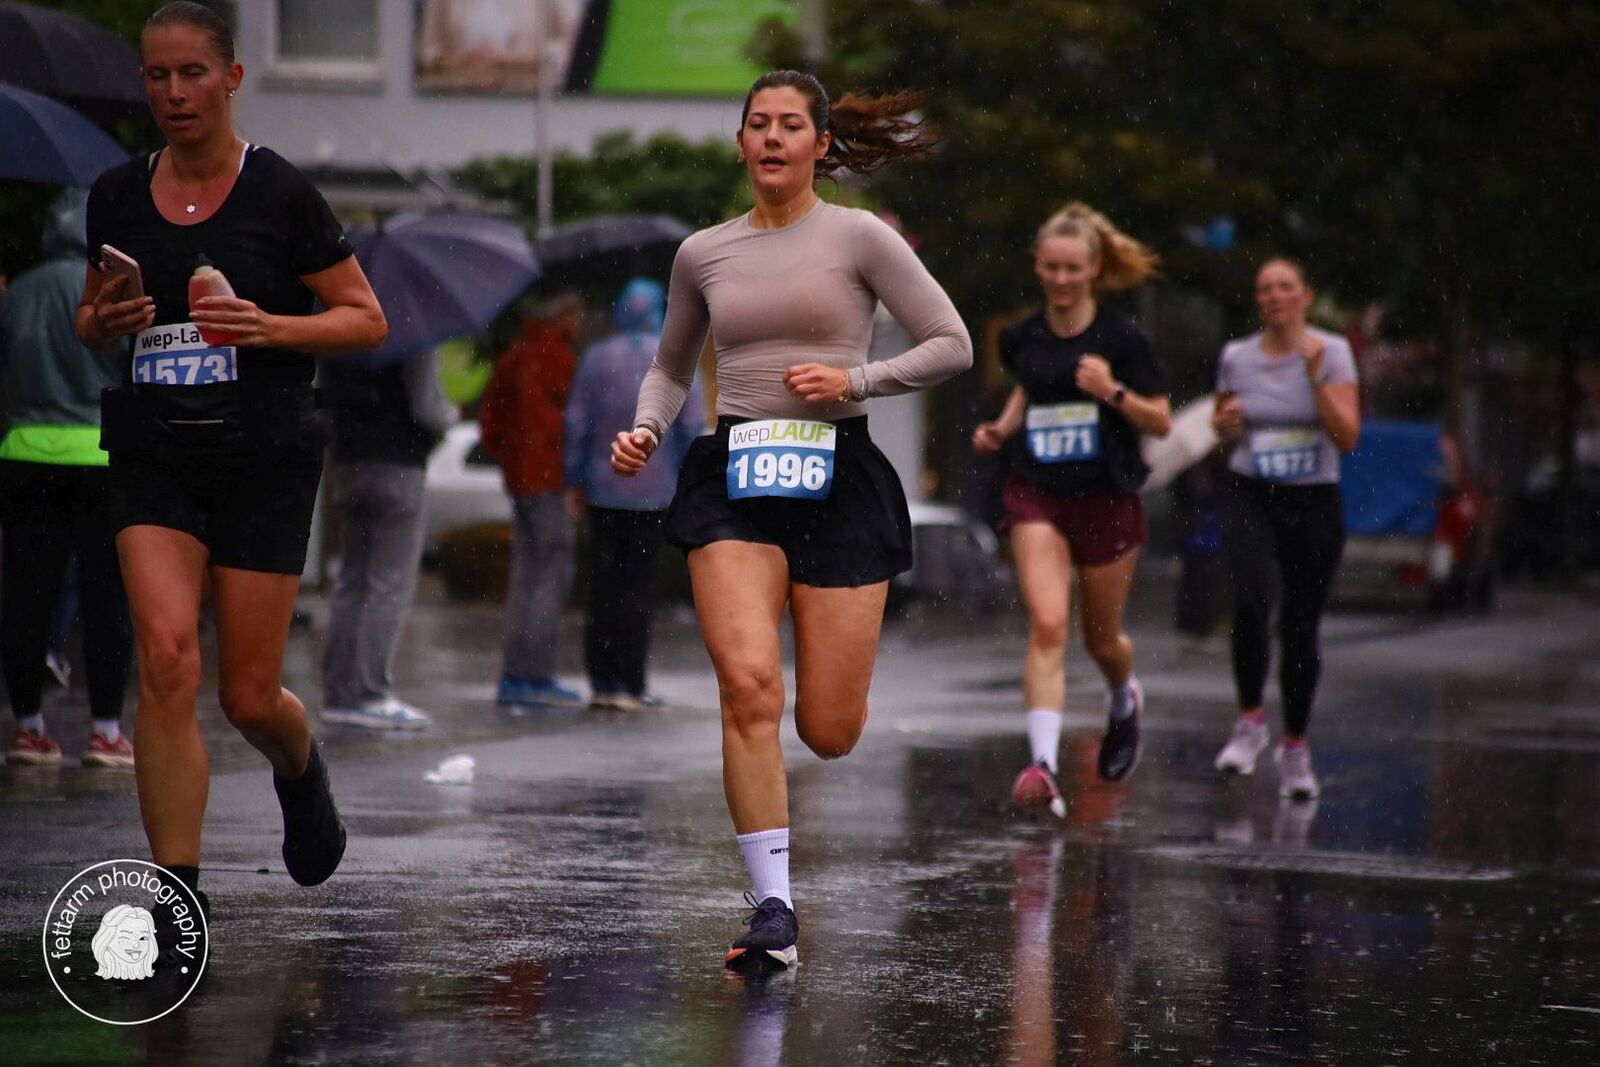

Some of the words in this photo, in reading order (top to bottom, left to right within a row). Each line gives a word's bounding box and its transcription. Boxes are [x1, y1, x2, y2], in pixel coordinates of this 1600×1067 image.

[142, 328, 200, 349] wep-La
[138, 355, 229, 385] 1573
[733, 422, 833, 445] wepLAUF
[1033, 427, 1092, 457] 1971
[735, 453, 826, 491] 1996
